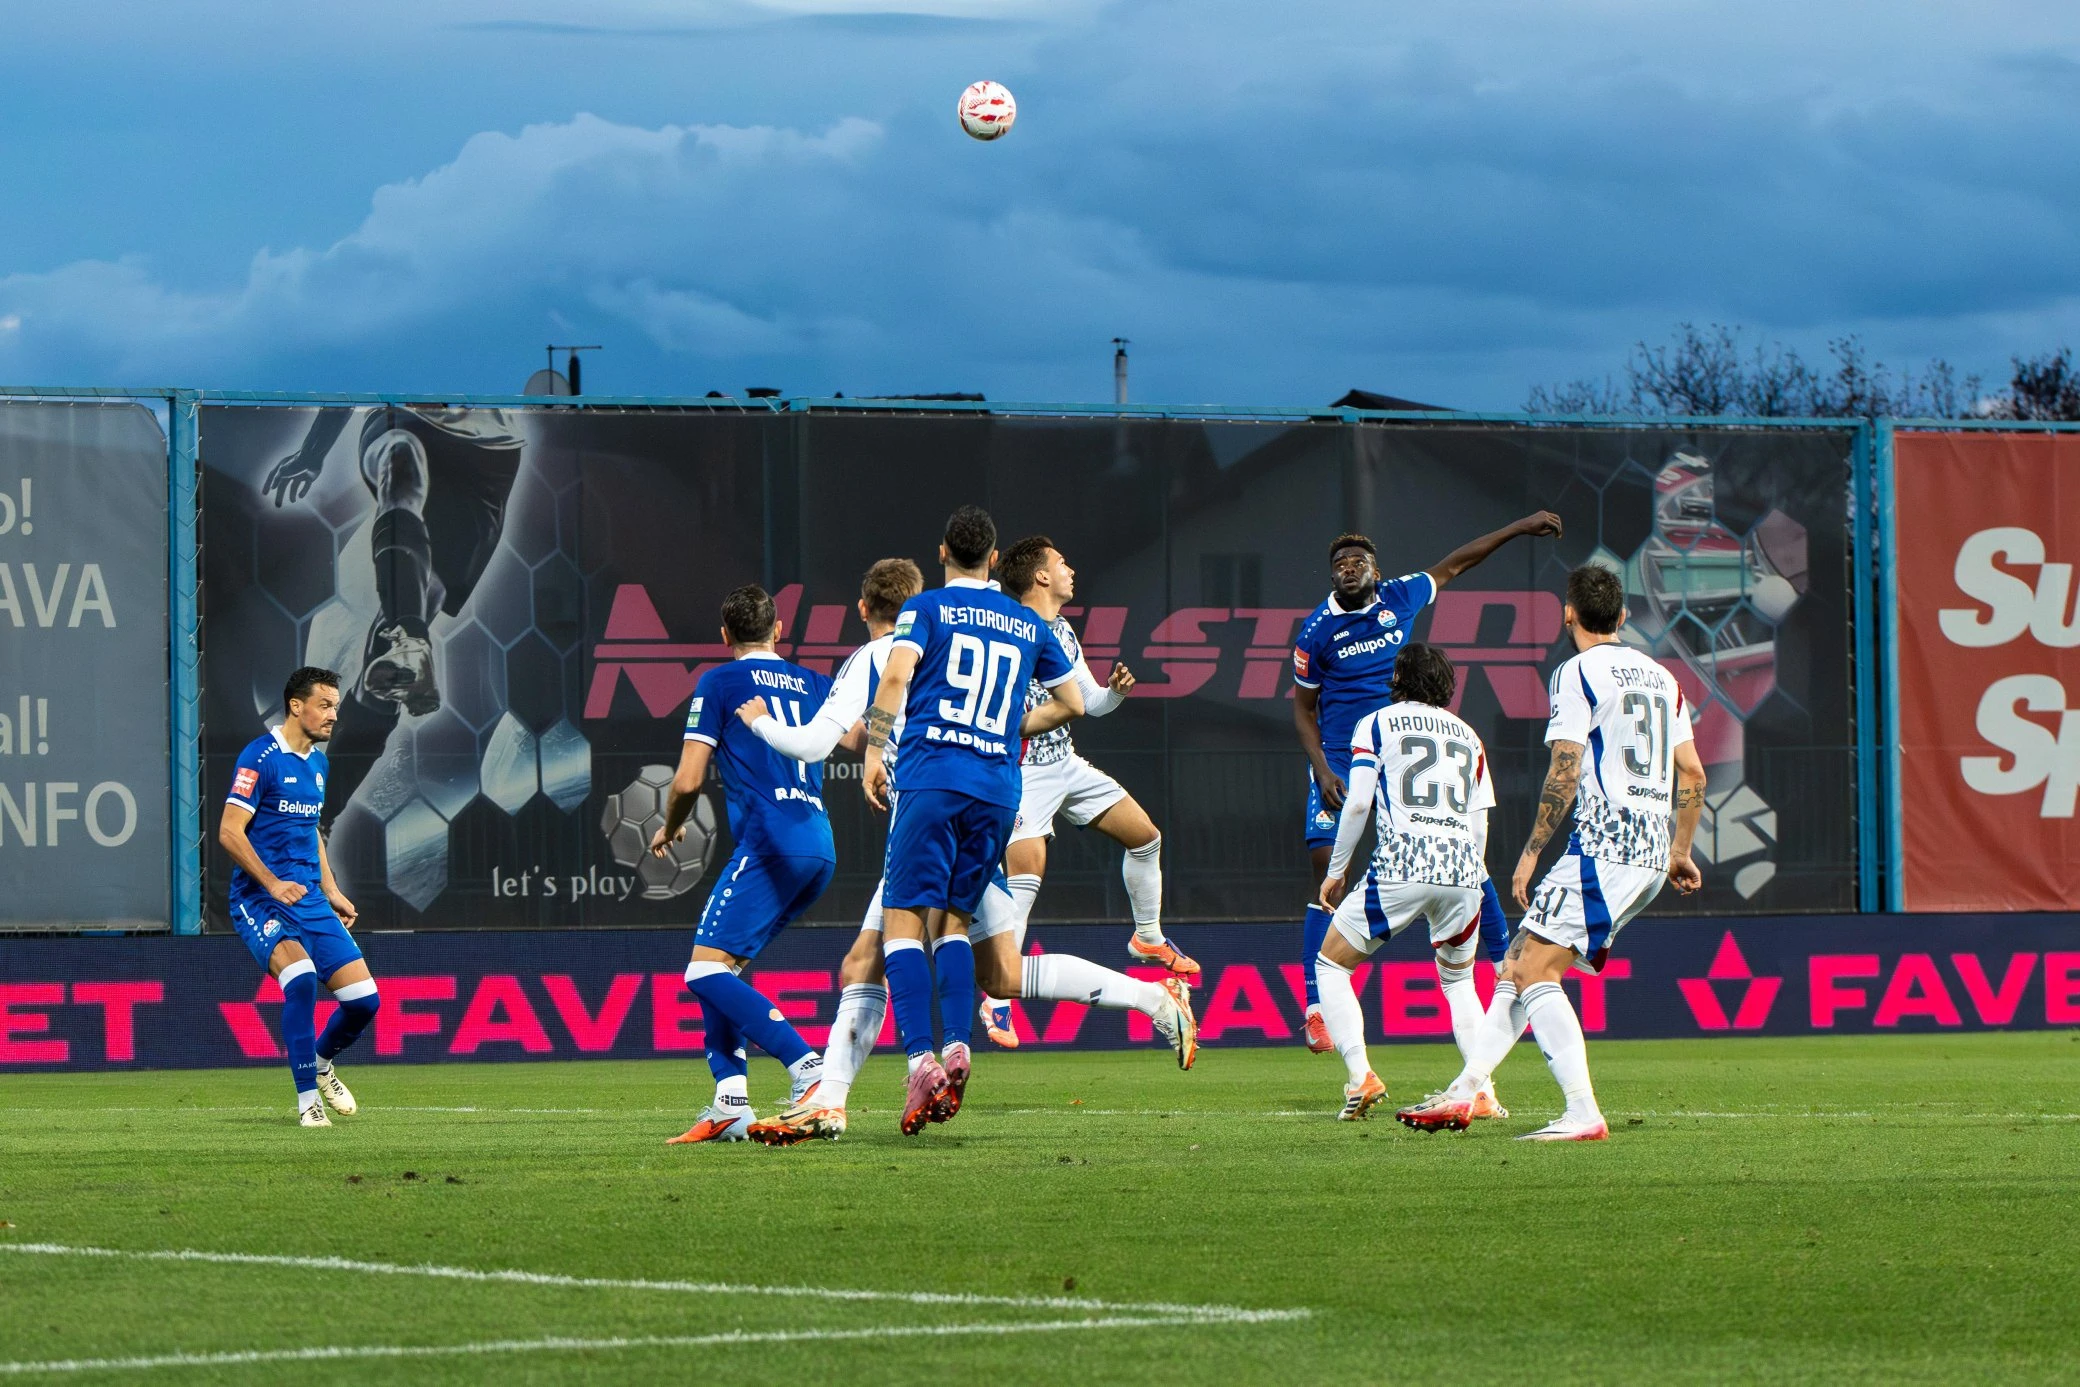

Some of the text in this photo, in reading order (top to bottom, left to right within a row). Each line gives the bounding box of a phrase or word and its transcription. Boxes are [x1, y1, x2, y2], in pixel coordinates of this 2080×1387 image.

[939, 605, 1037, 643] NESTOROVSKI
[1333, 630, 1350, 642] JAKO
[1337, 637, 1387, 660] Belupo
[938, 631, 1022, 736] 90
[925, 725, 1008, 755] RADNIK
[1621, 690, 1670, 783] 31
[1399, 734, 1473, 816] 23
[278, 800, 318, 817] Belupo
[492, 864, 636, 903] let's play
